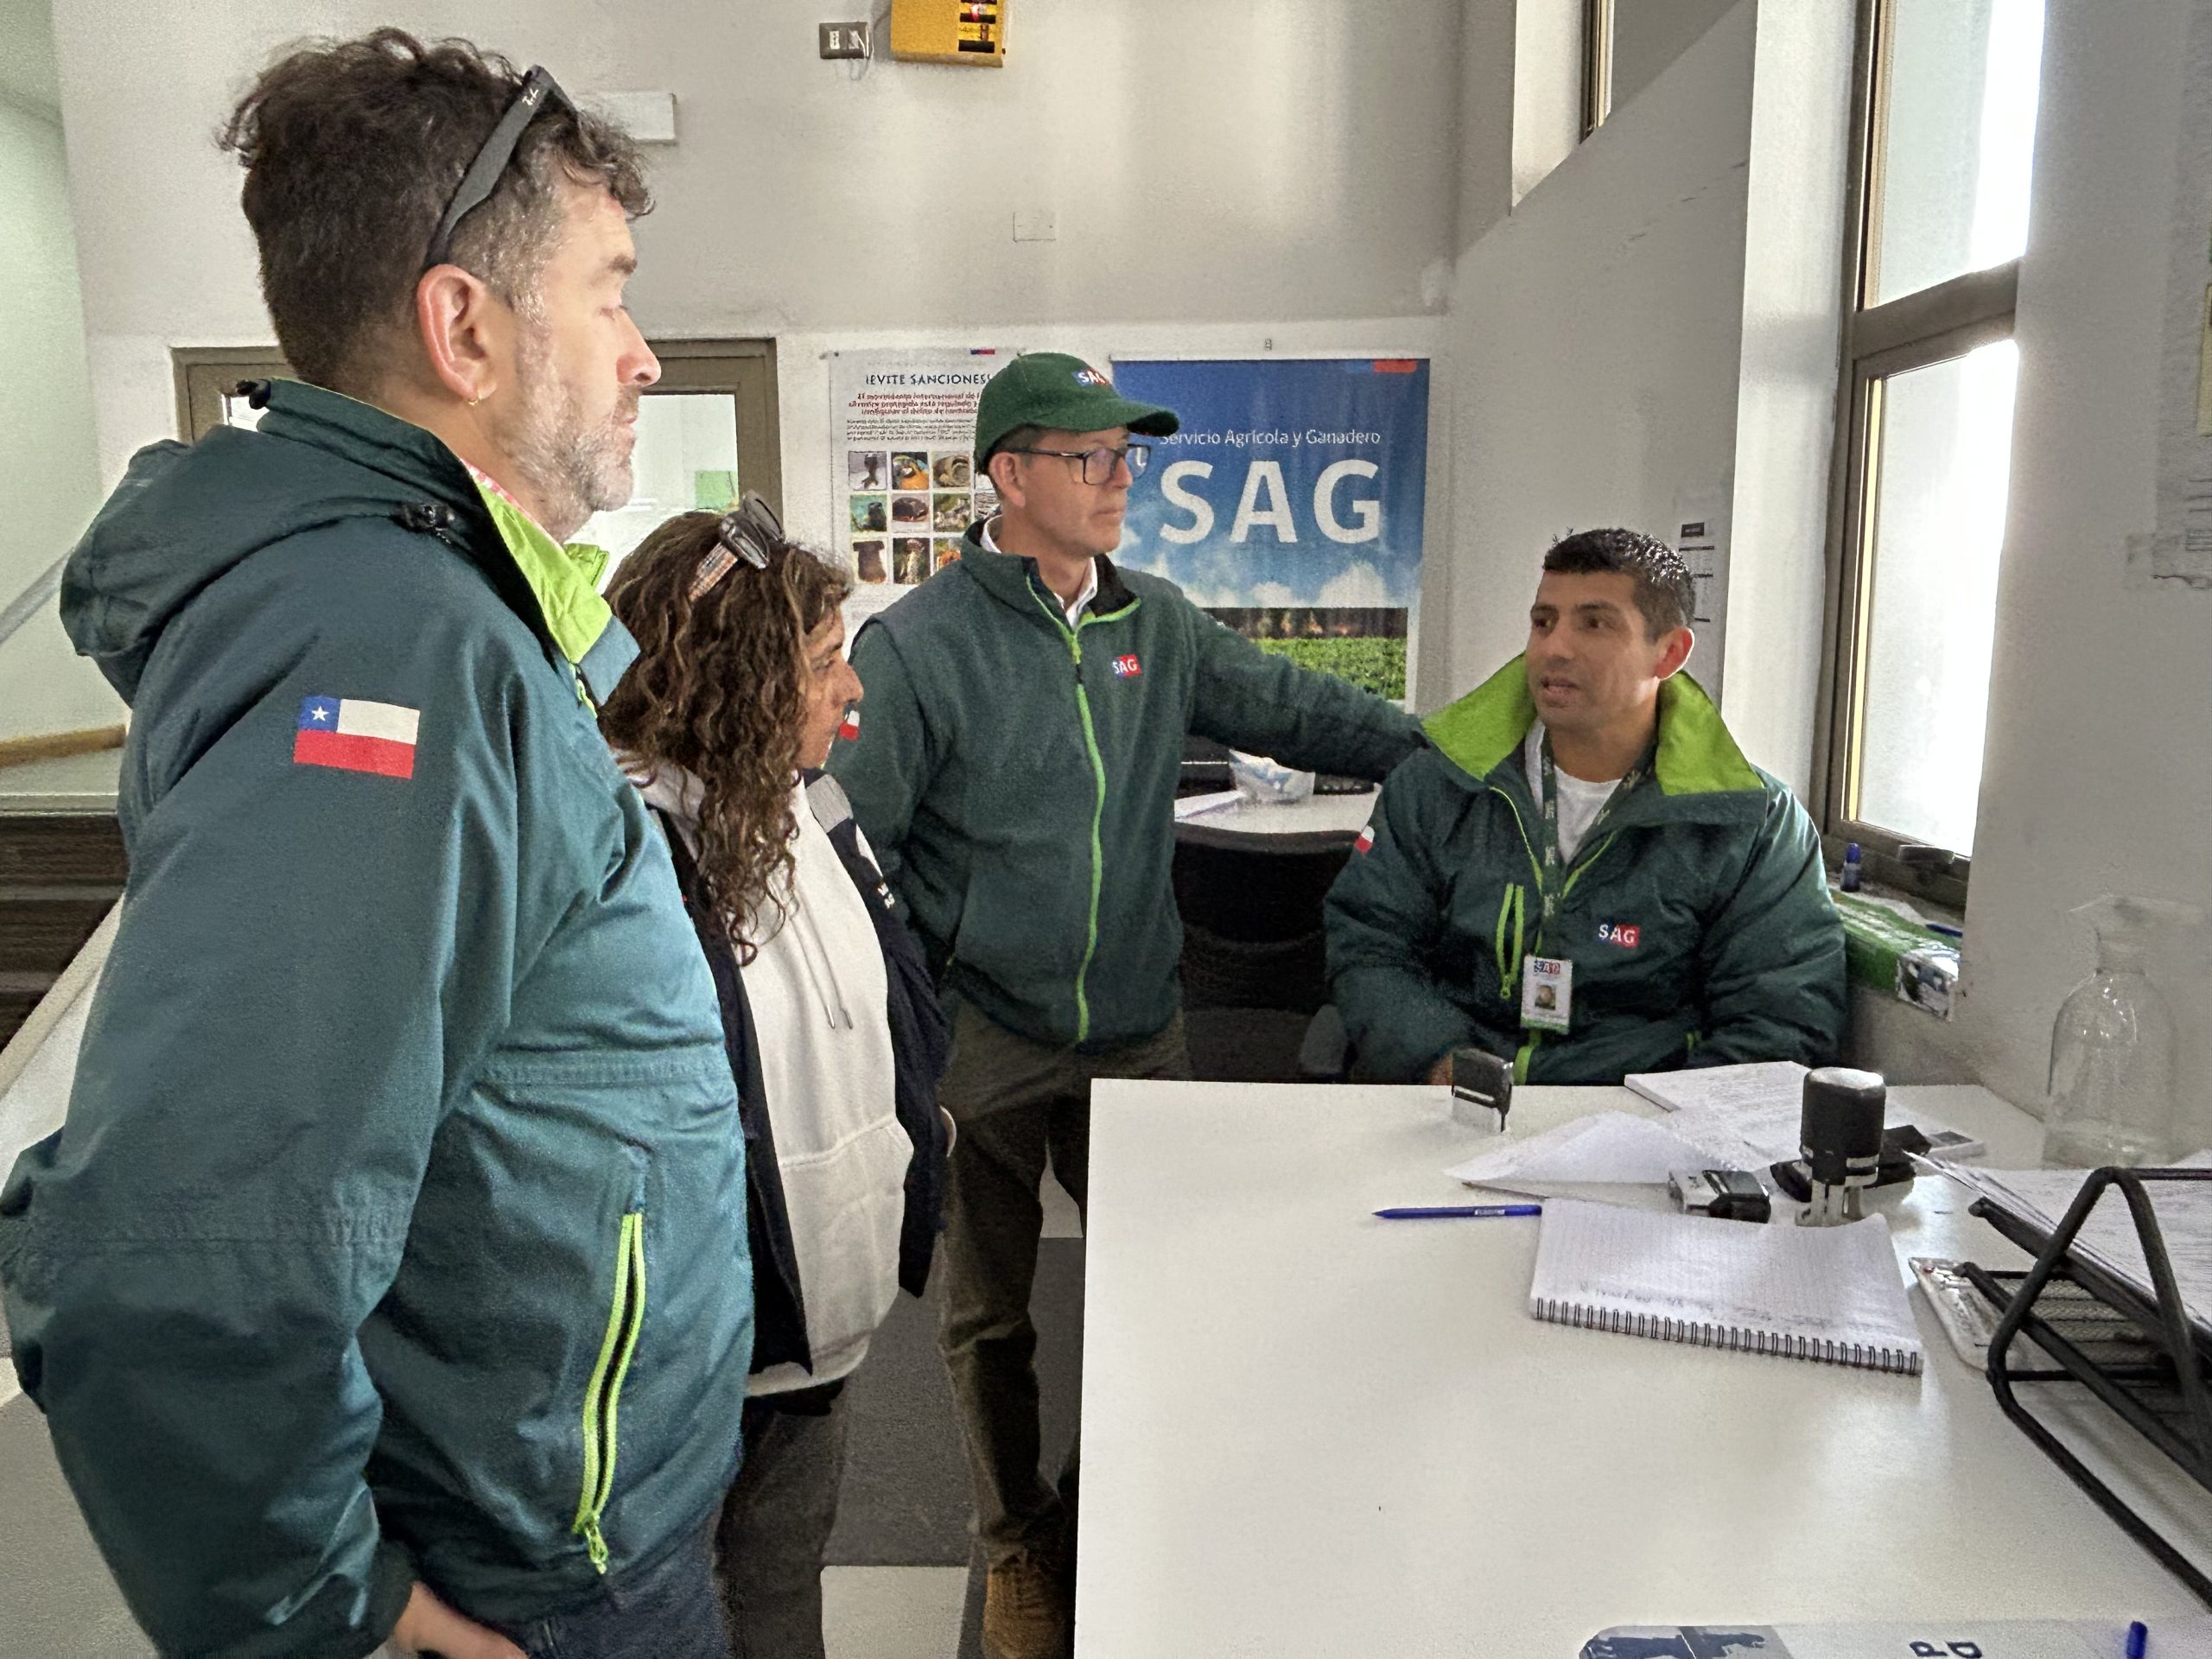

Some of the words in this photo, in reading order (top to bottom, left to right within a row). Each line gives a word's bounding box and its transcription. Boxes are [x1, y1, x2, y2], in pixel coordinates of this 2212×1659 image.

[1292, 431, 1302, 448] y
[1306, 429, 1381, 445] Ganadero
[1160, 459, 1380, 544] SAG
[1112, 658, 1138, 674] SAG
[1598, 923, 1636, 944] SAG
